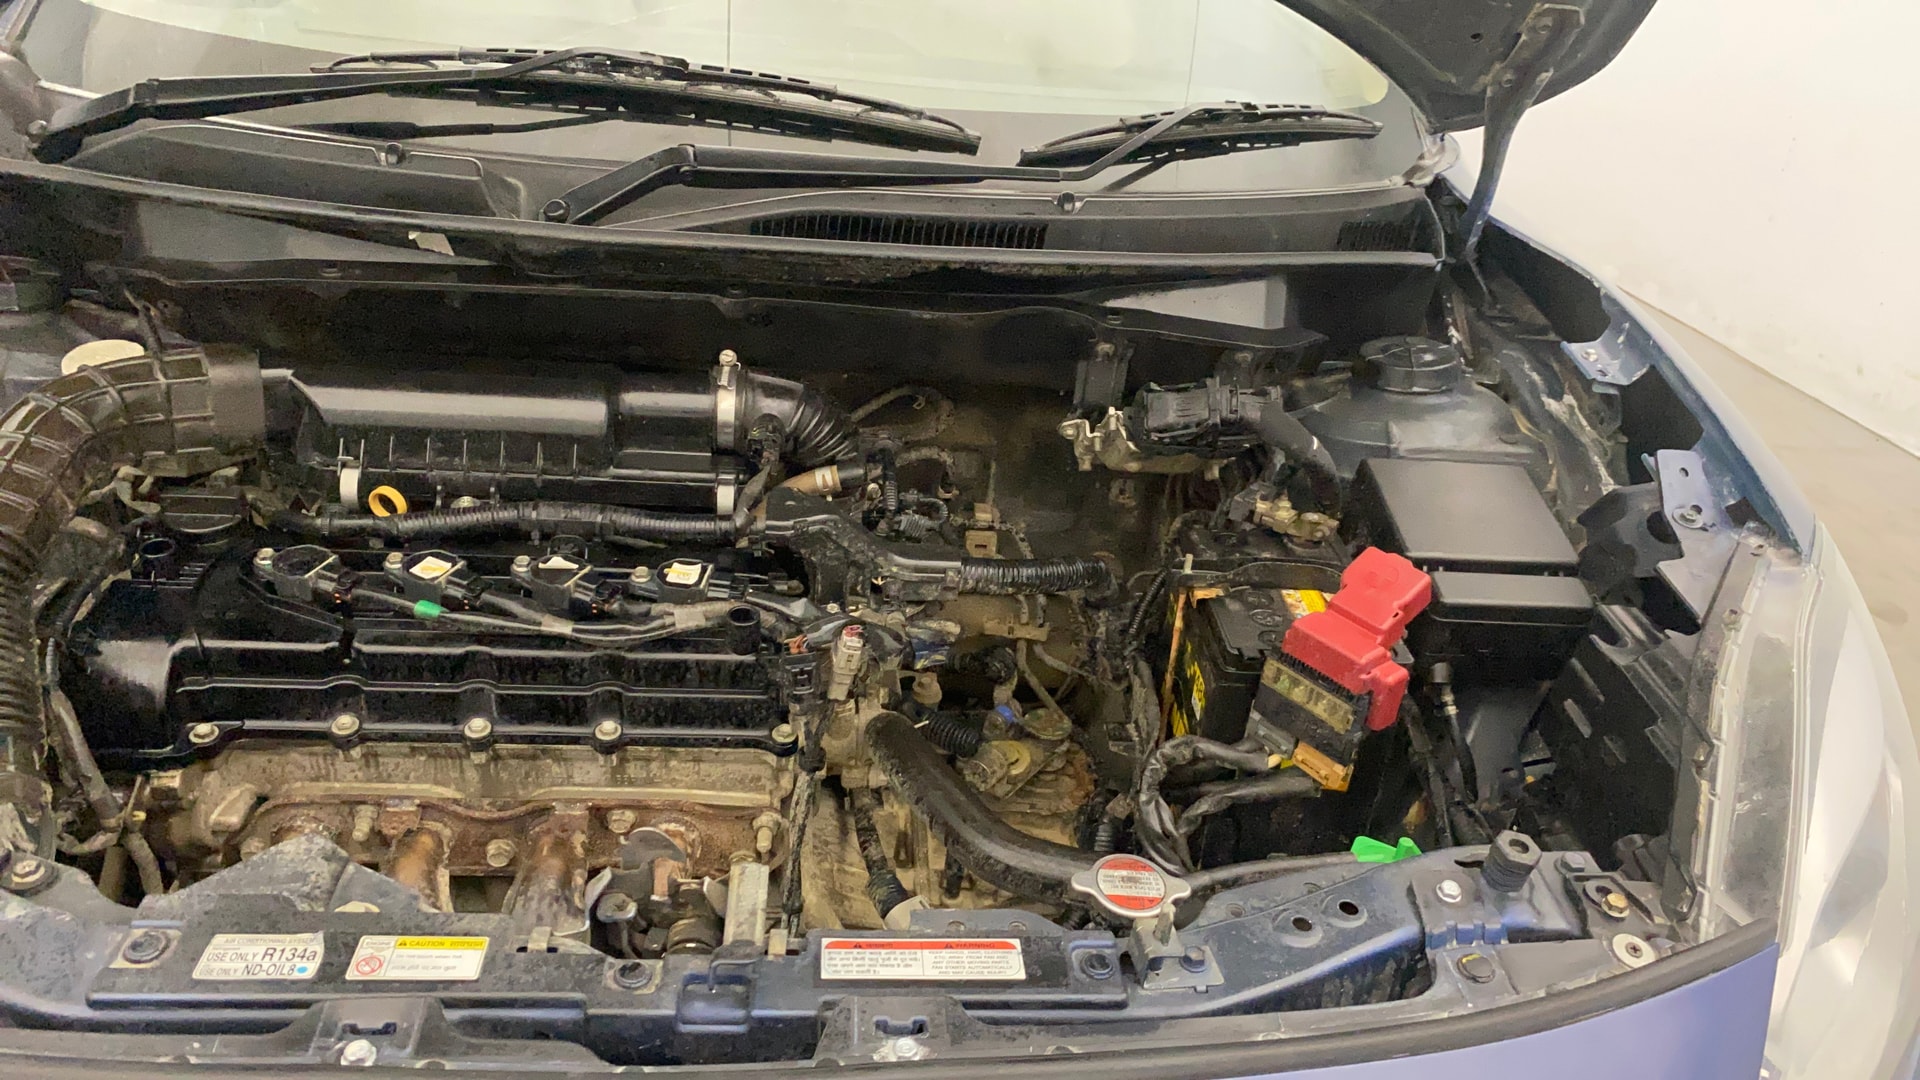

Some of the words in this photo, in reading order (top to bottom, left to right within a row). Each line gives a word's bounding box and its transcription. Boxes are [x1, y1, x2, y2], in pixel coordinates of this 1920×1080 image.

[206, 952, 226, 962] USE
[229, 952, 259, 962] ONLY
[261, 947, 318, 962] R134a
[217, 966, 239, 976] ONLY
[241, 964, 297, 976] ND-OIL8
